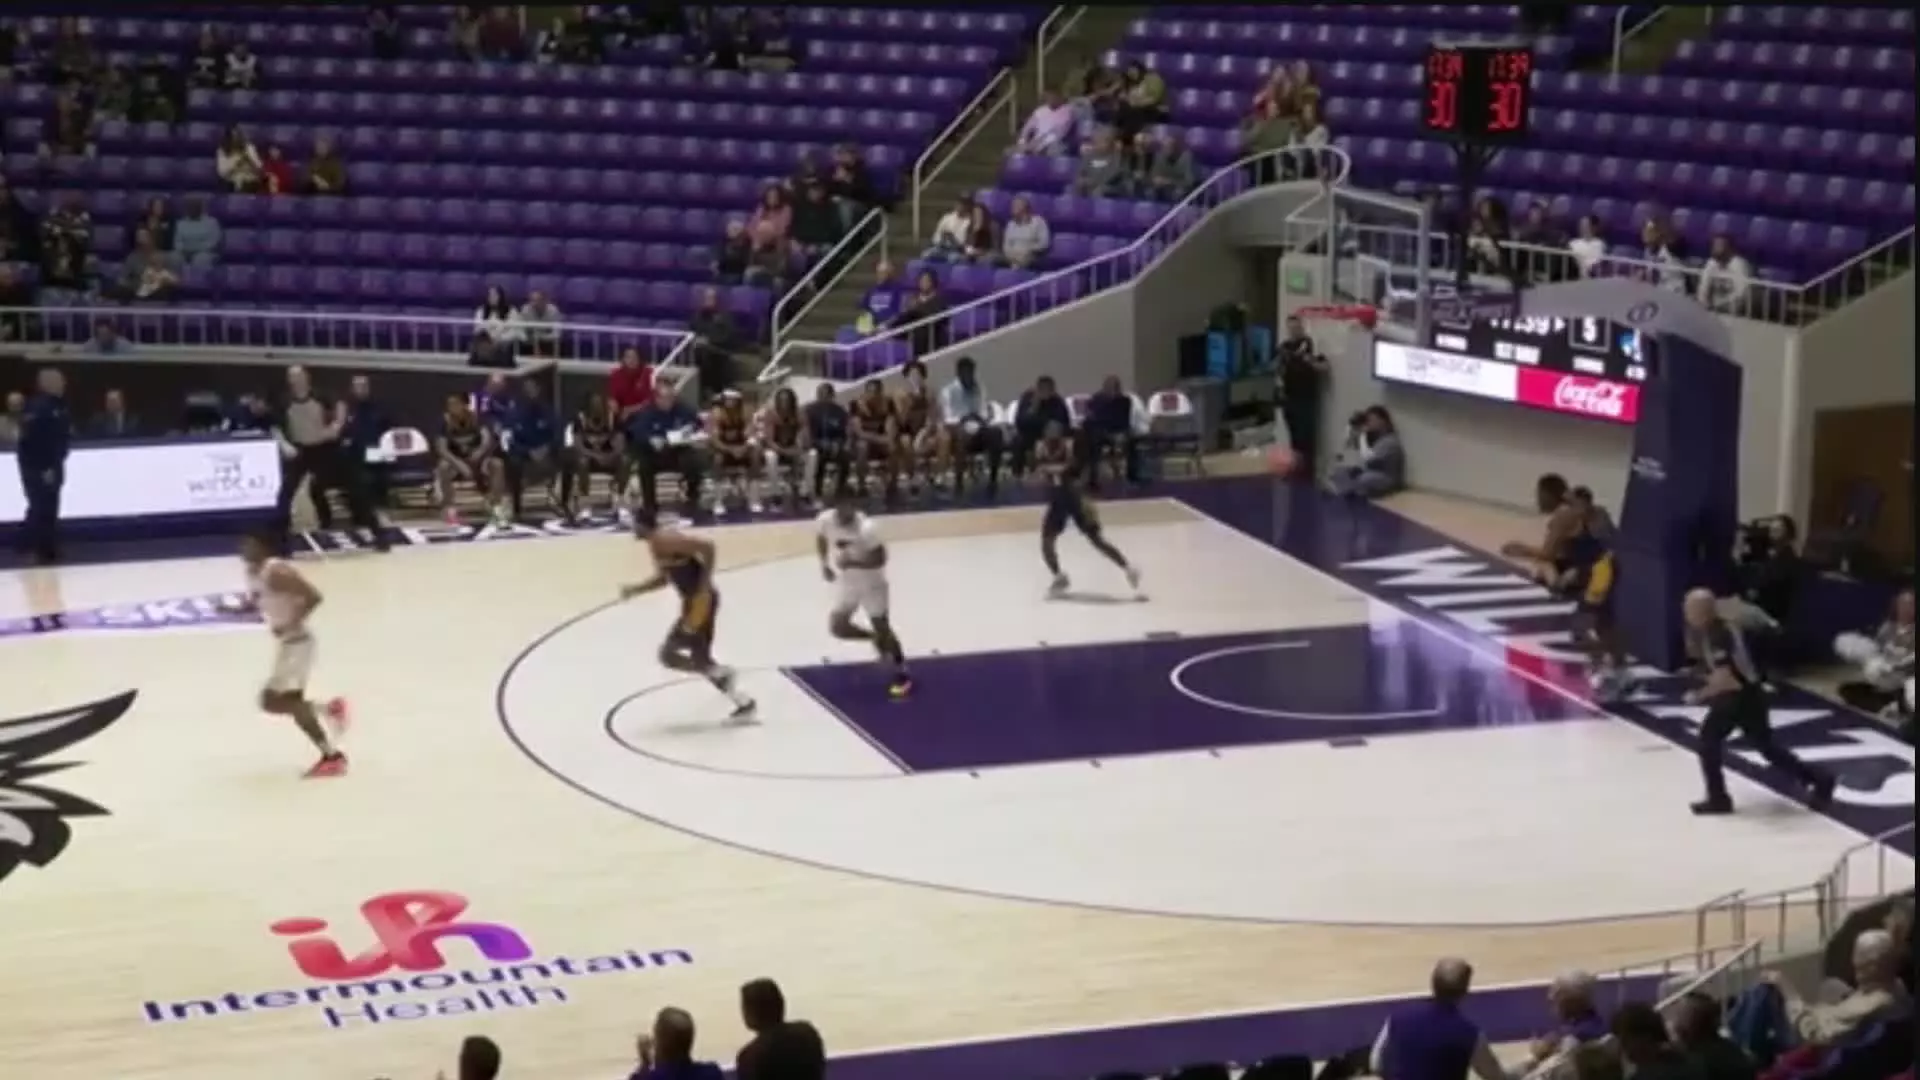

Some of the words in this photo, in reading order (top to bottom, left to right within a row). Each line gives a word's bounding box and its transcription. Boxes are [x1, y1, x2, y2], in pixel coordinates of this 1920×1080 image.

[1428, 81, 1456, 128] 30
[1487, 82, 1521, 129] 30
[144, 946, 696, 1024] Intermountain
[322, 982, 569, 1030] Health
